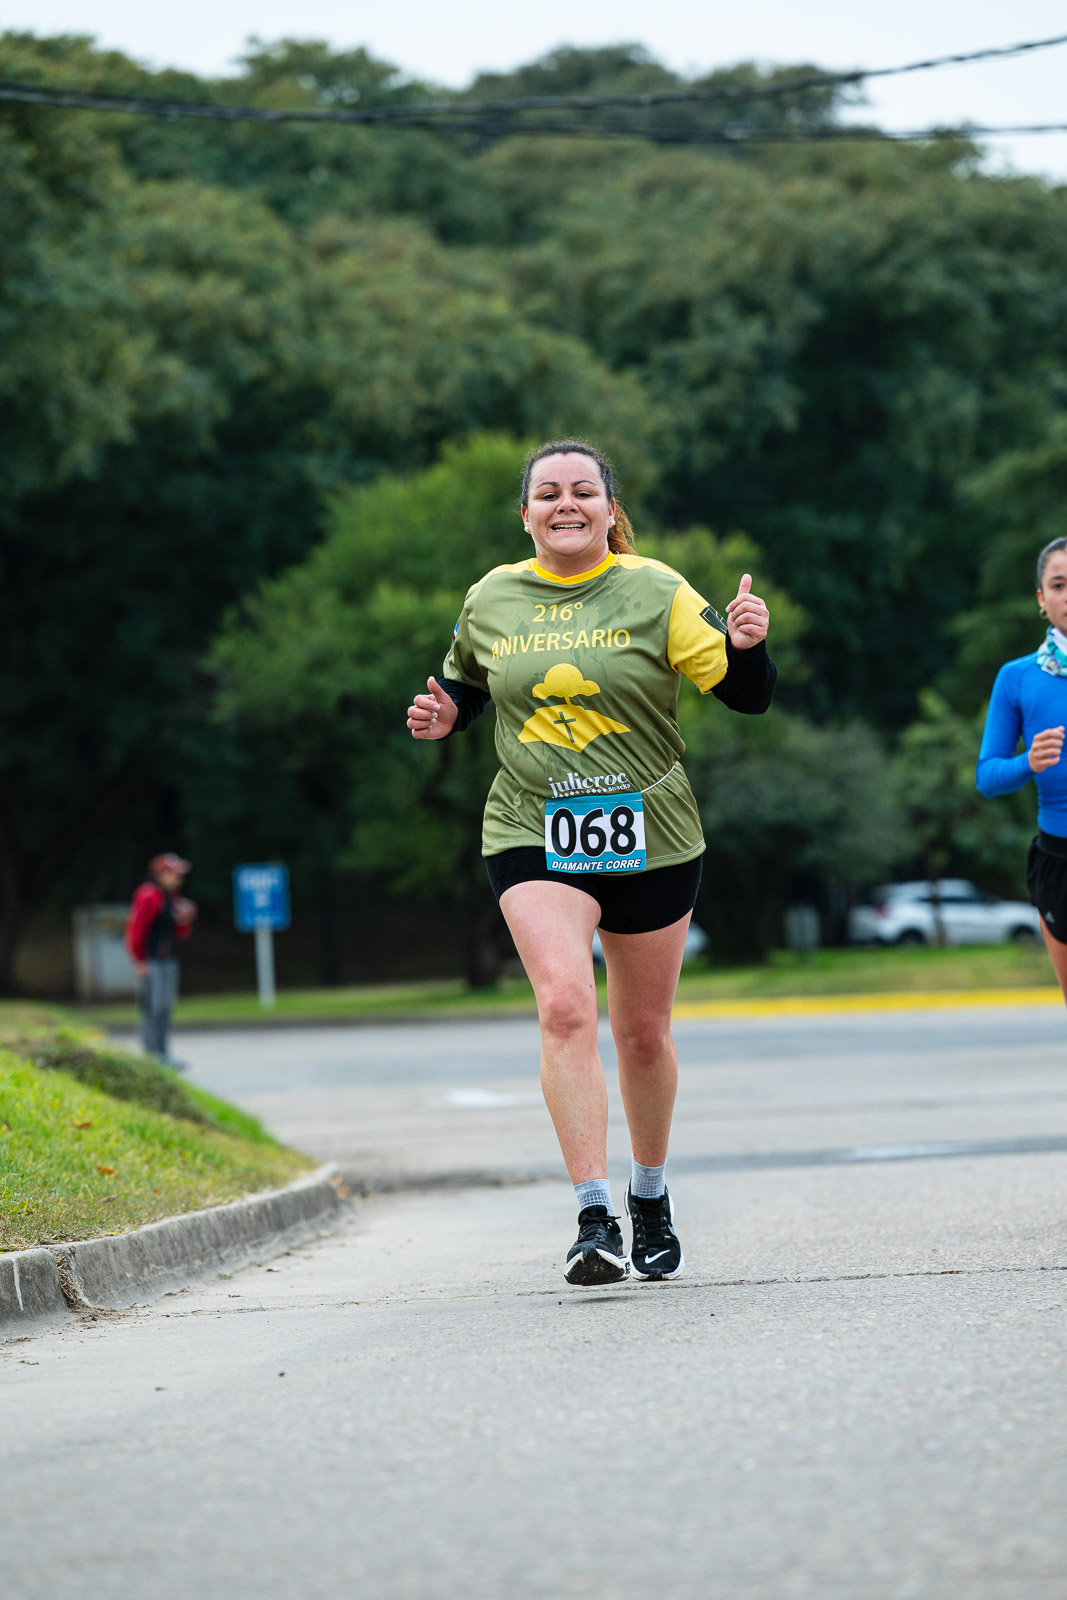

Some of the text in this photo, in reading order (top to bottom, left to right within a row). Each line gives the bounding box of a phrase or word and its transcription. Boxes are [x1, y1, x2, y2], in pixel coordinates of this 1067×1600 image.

[491, 628, 631, 661] ANIVERSARIO
[548, 772, 629, 798] julicroc
[551, 805, 637, 858] 068
[551, 859, 641, 871] DIAMANTE CORRE
